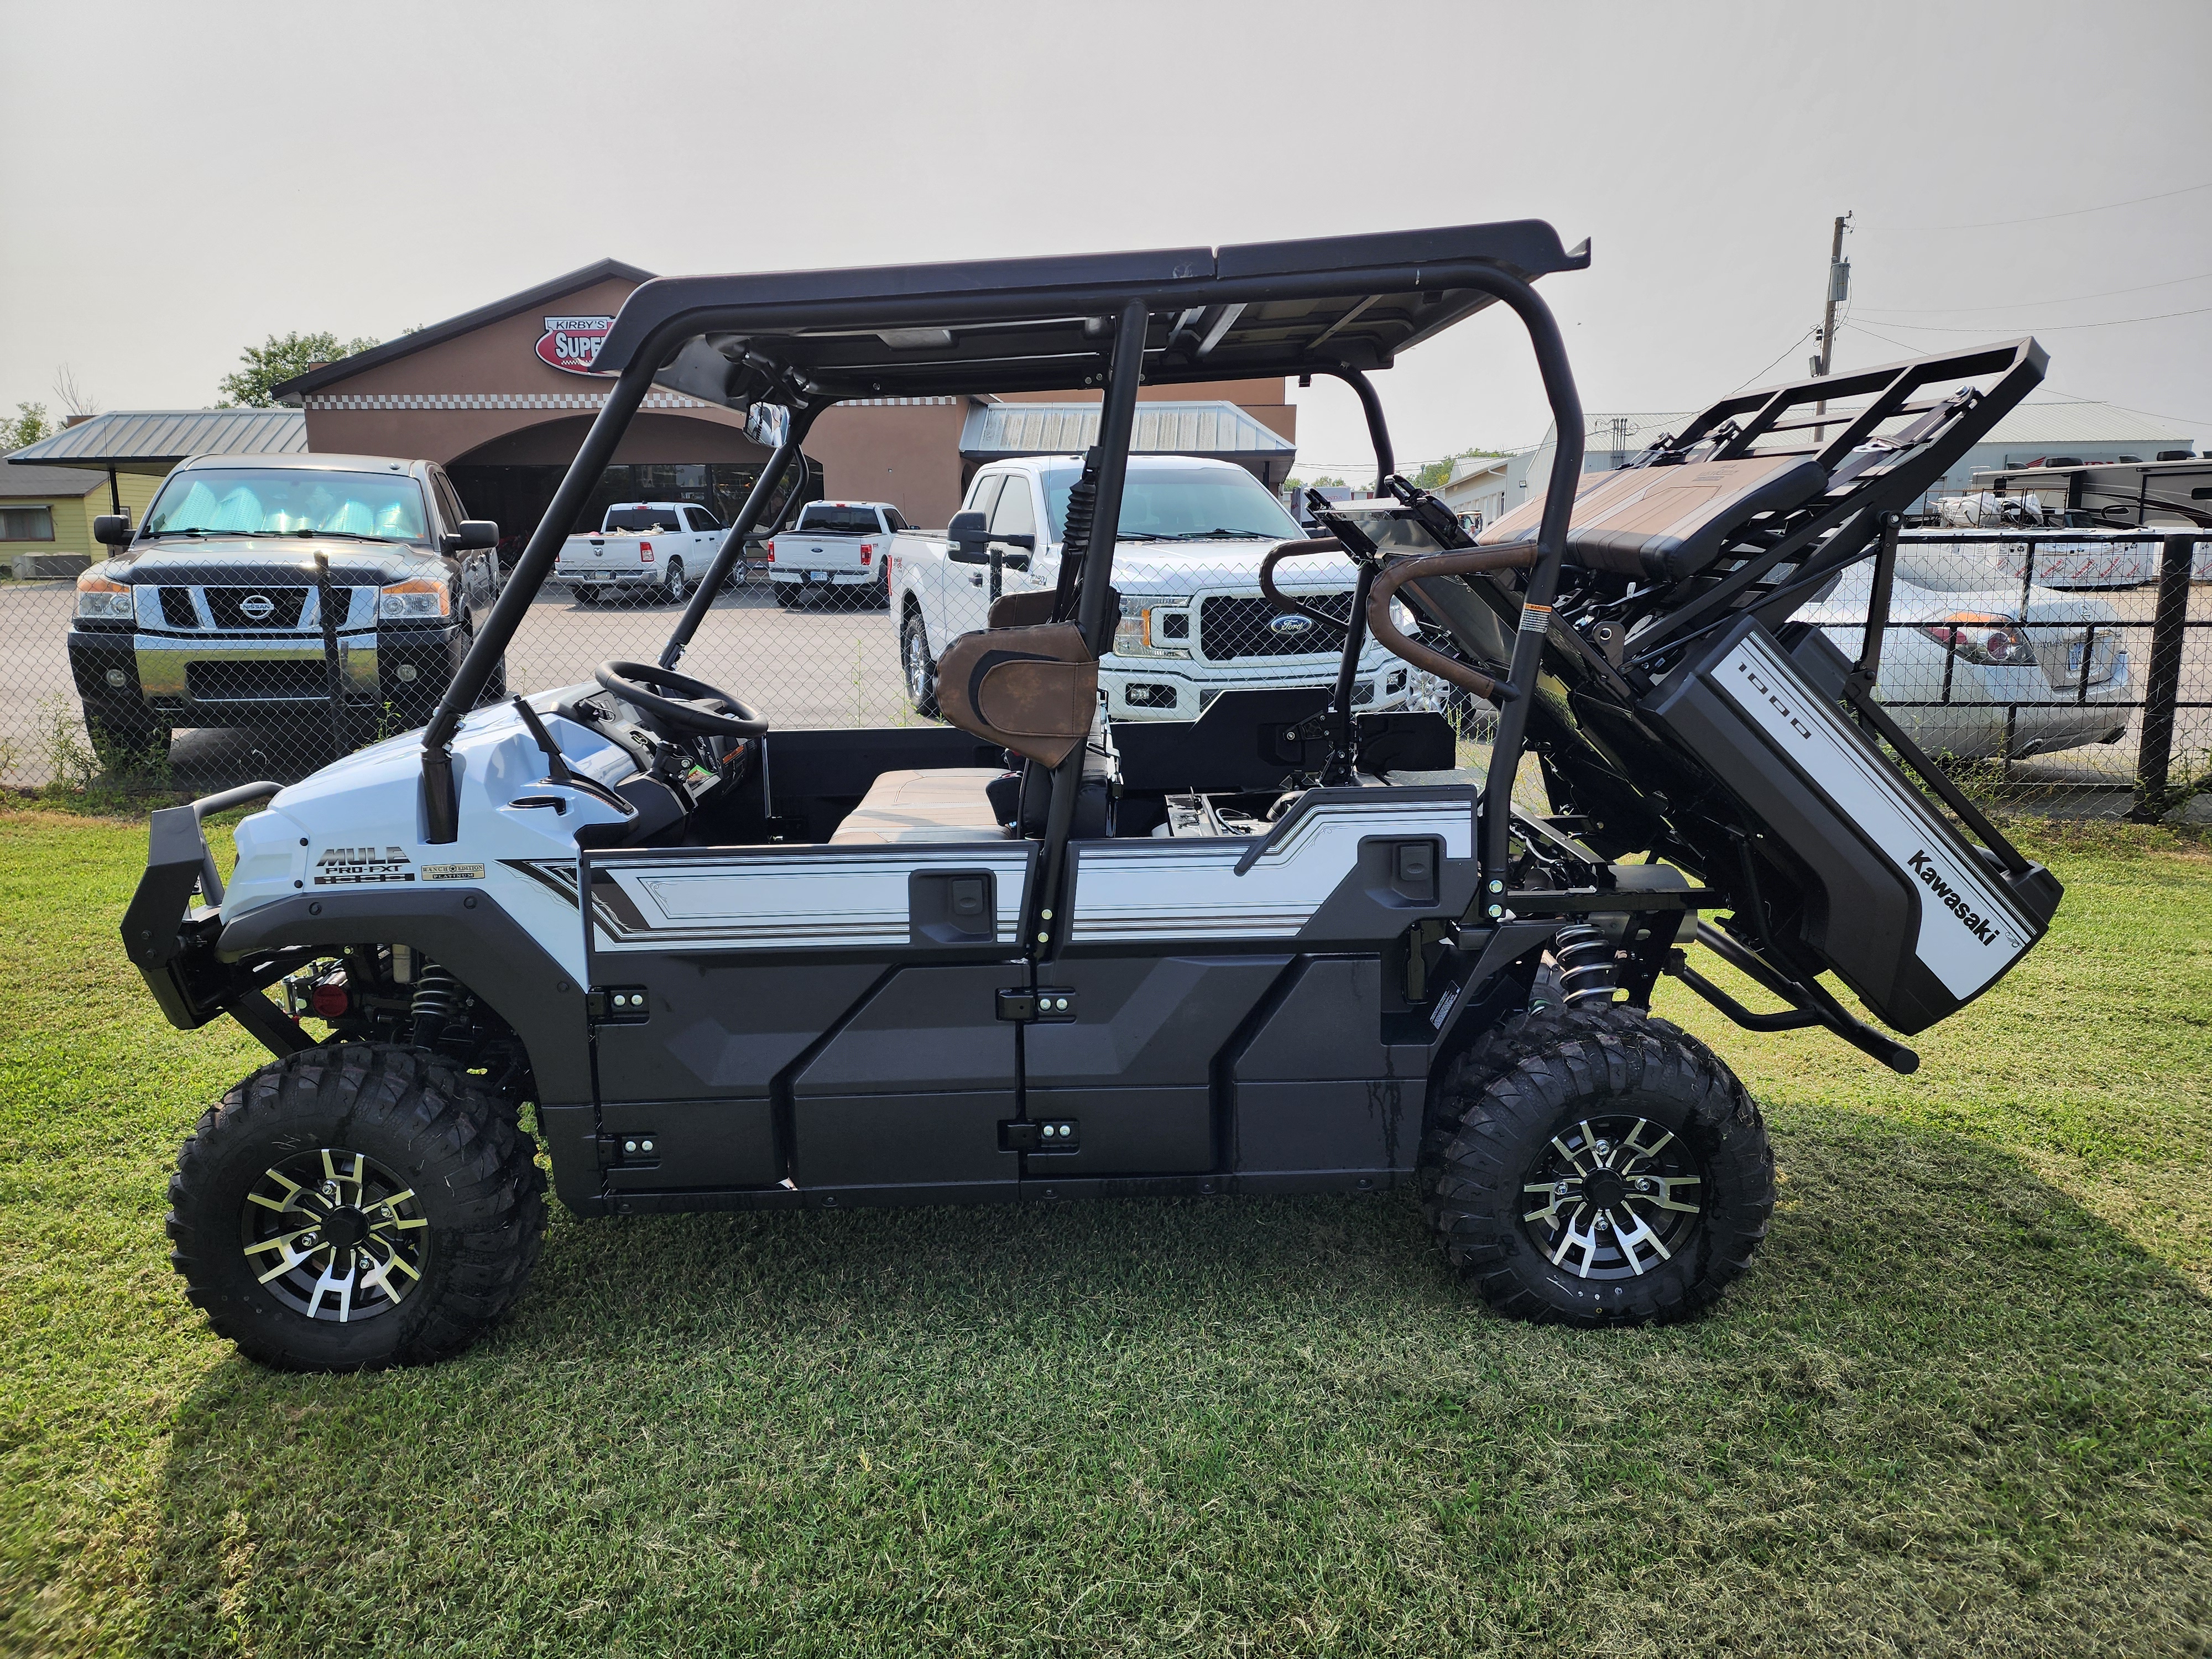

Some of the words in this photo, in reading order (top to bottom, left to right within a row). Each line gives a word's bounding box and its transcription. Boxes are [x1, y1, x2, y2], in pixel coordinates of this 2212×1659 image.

[556, 321, 605, 329] KIRBY'S
[555, 331, 605, 358] SUPE
[1281, 619, 1303, 630] Ford
[1738, 661, 1812, 740] 1000
[316, 846, 411, 867] MULE
[325, 865, 403, 874] PRO-FXT
[322, 874, 406, 884] 1000
[1907, 849, 2001, 947] Kawasaki
